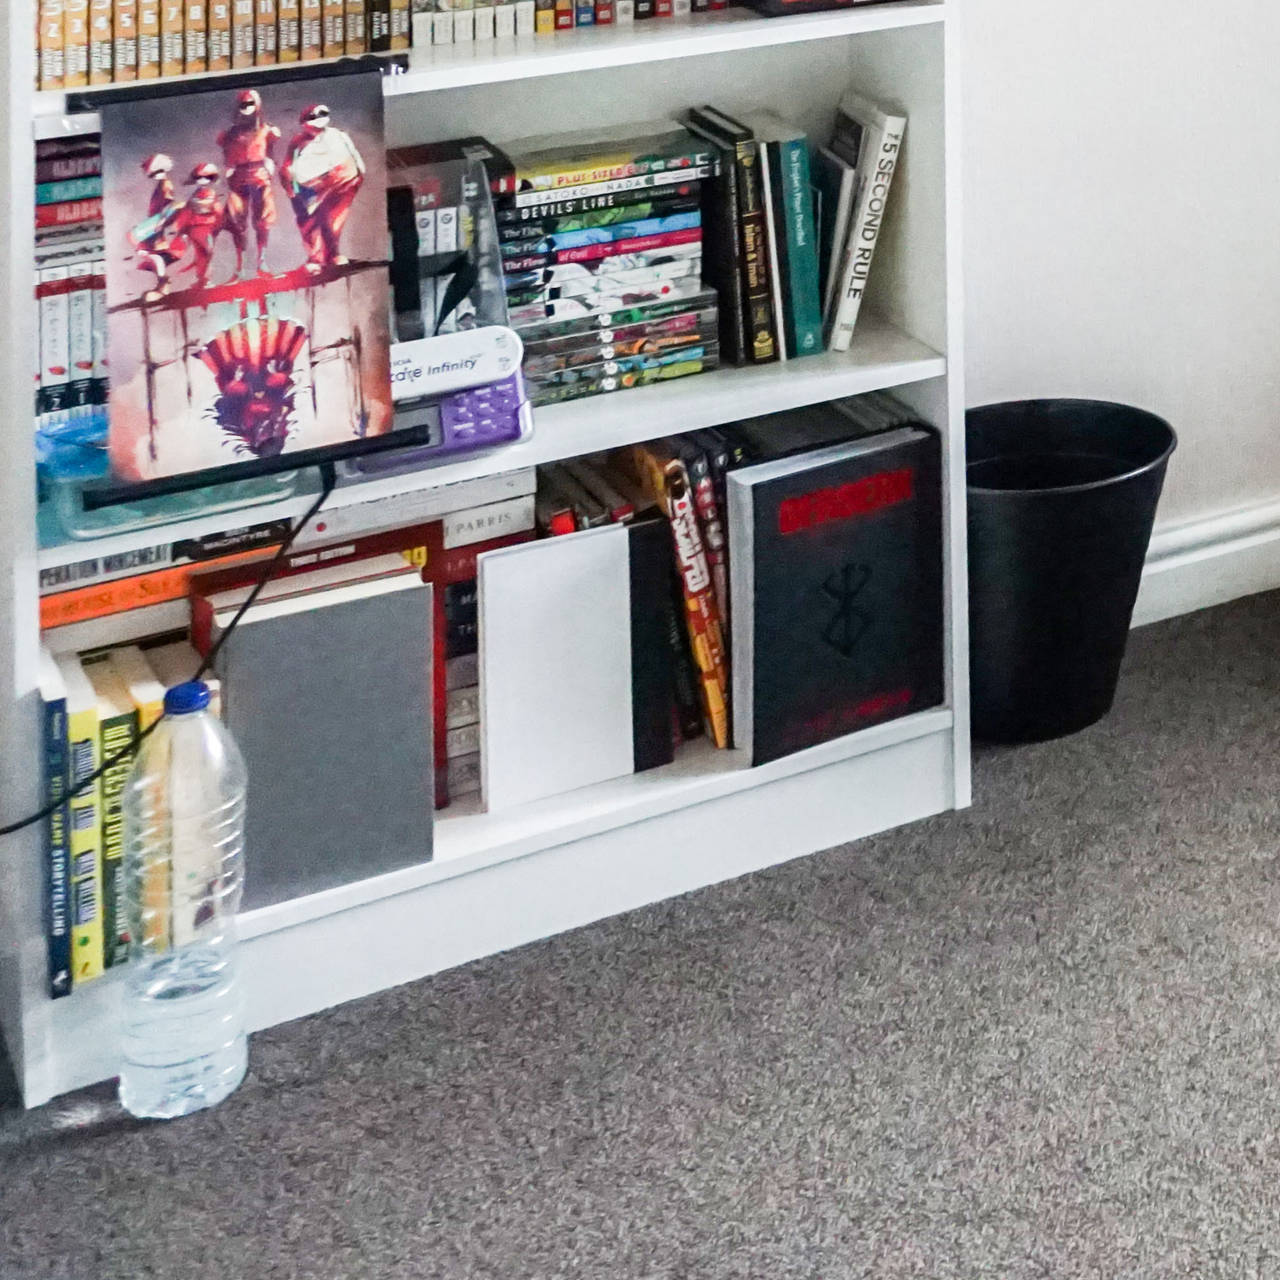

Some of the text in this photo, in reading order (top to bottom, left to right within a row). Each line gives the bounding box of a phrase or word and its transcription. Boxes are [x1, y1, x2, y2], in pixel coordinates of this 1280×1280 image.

[214, 5, 226, 19] 9
[46, 22, 58, 38] 2
[535, 187, 588, 203] SATOKO
[582, 195, 615, 210] LINE
[846, 141, 897, 300] 5 SECOND RULE
[745, 224, 757, 252] Islam
[427, 358, 477, 376] Infinity
[455, 511, 512, 529] PARRIS
[52, 849, 65, 936] STORYTELLING
